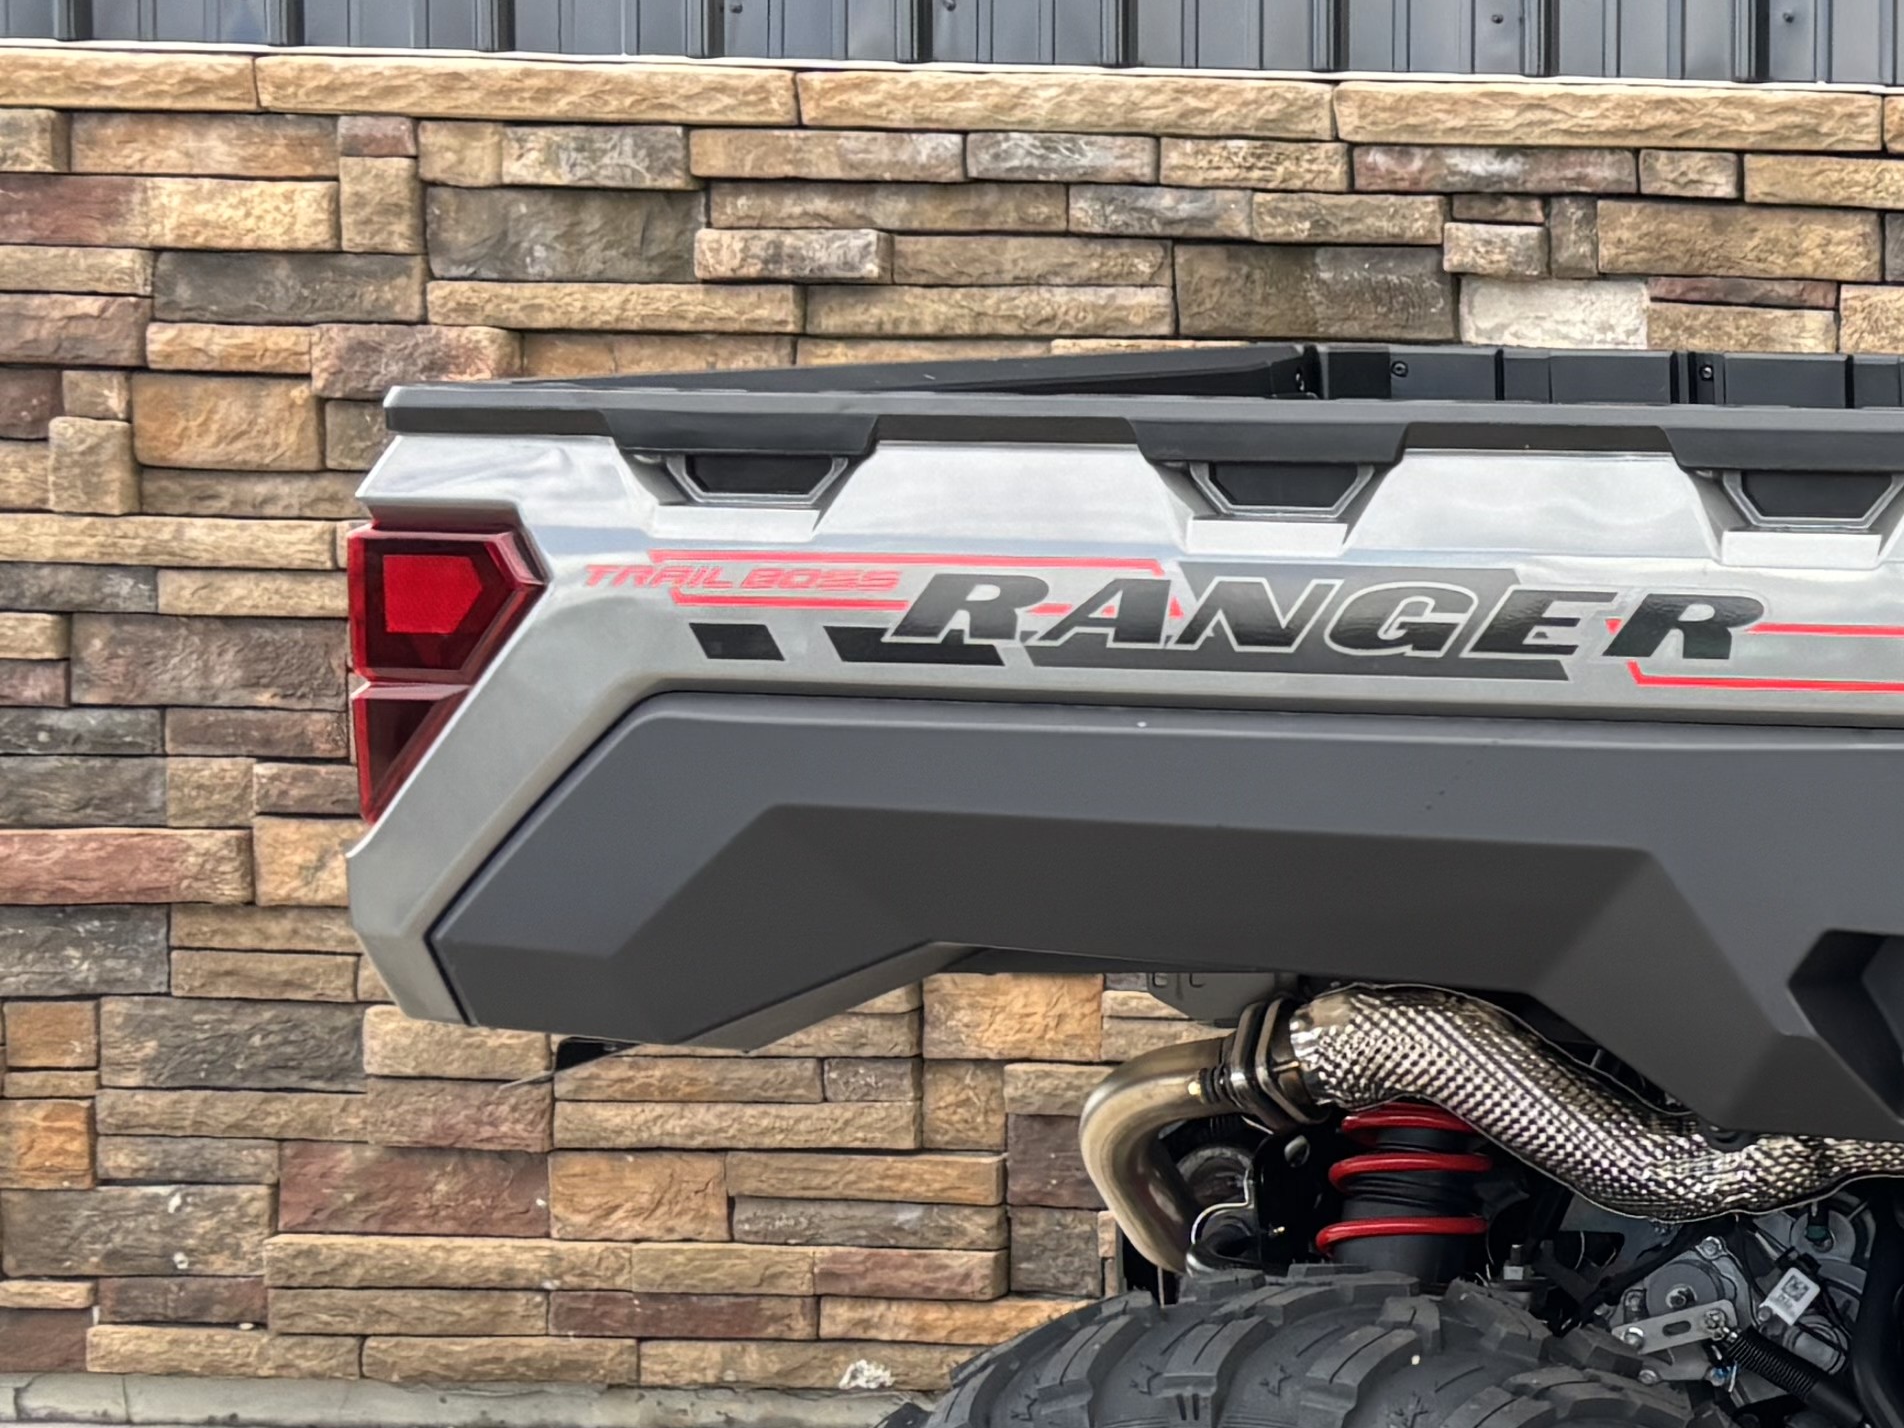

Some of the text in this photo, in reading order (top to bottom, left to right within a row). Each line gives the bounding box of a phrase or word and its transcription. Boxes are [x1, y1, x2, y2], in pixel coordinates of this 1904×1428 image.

[584, 564, 904, 592] TRAIL BOSS
[882, 572, 1768, 662] RANGER
